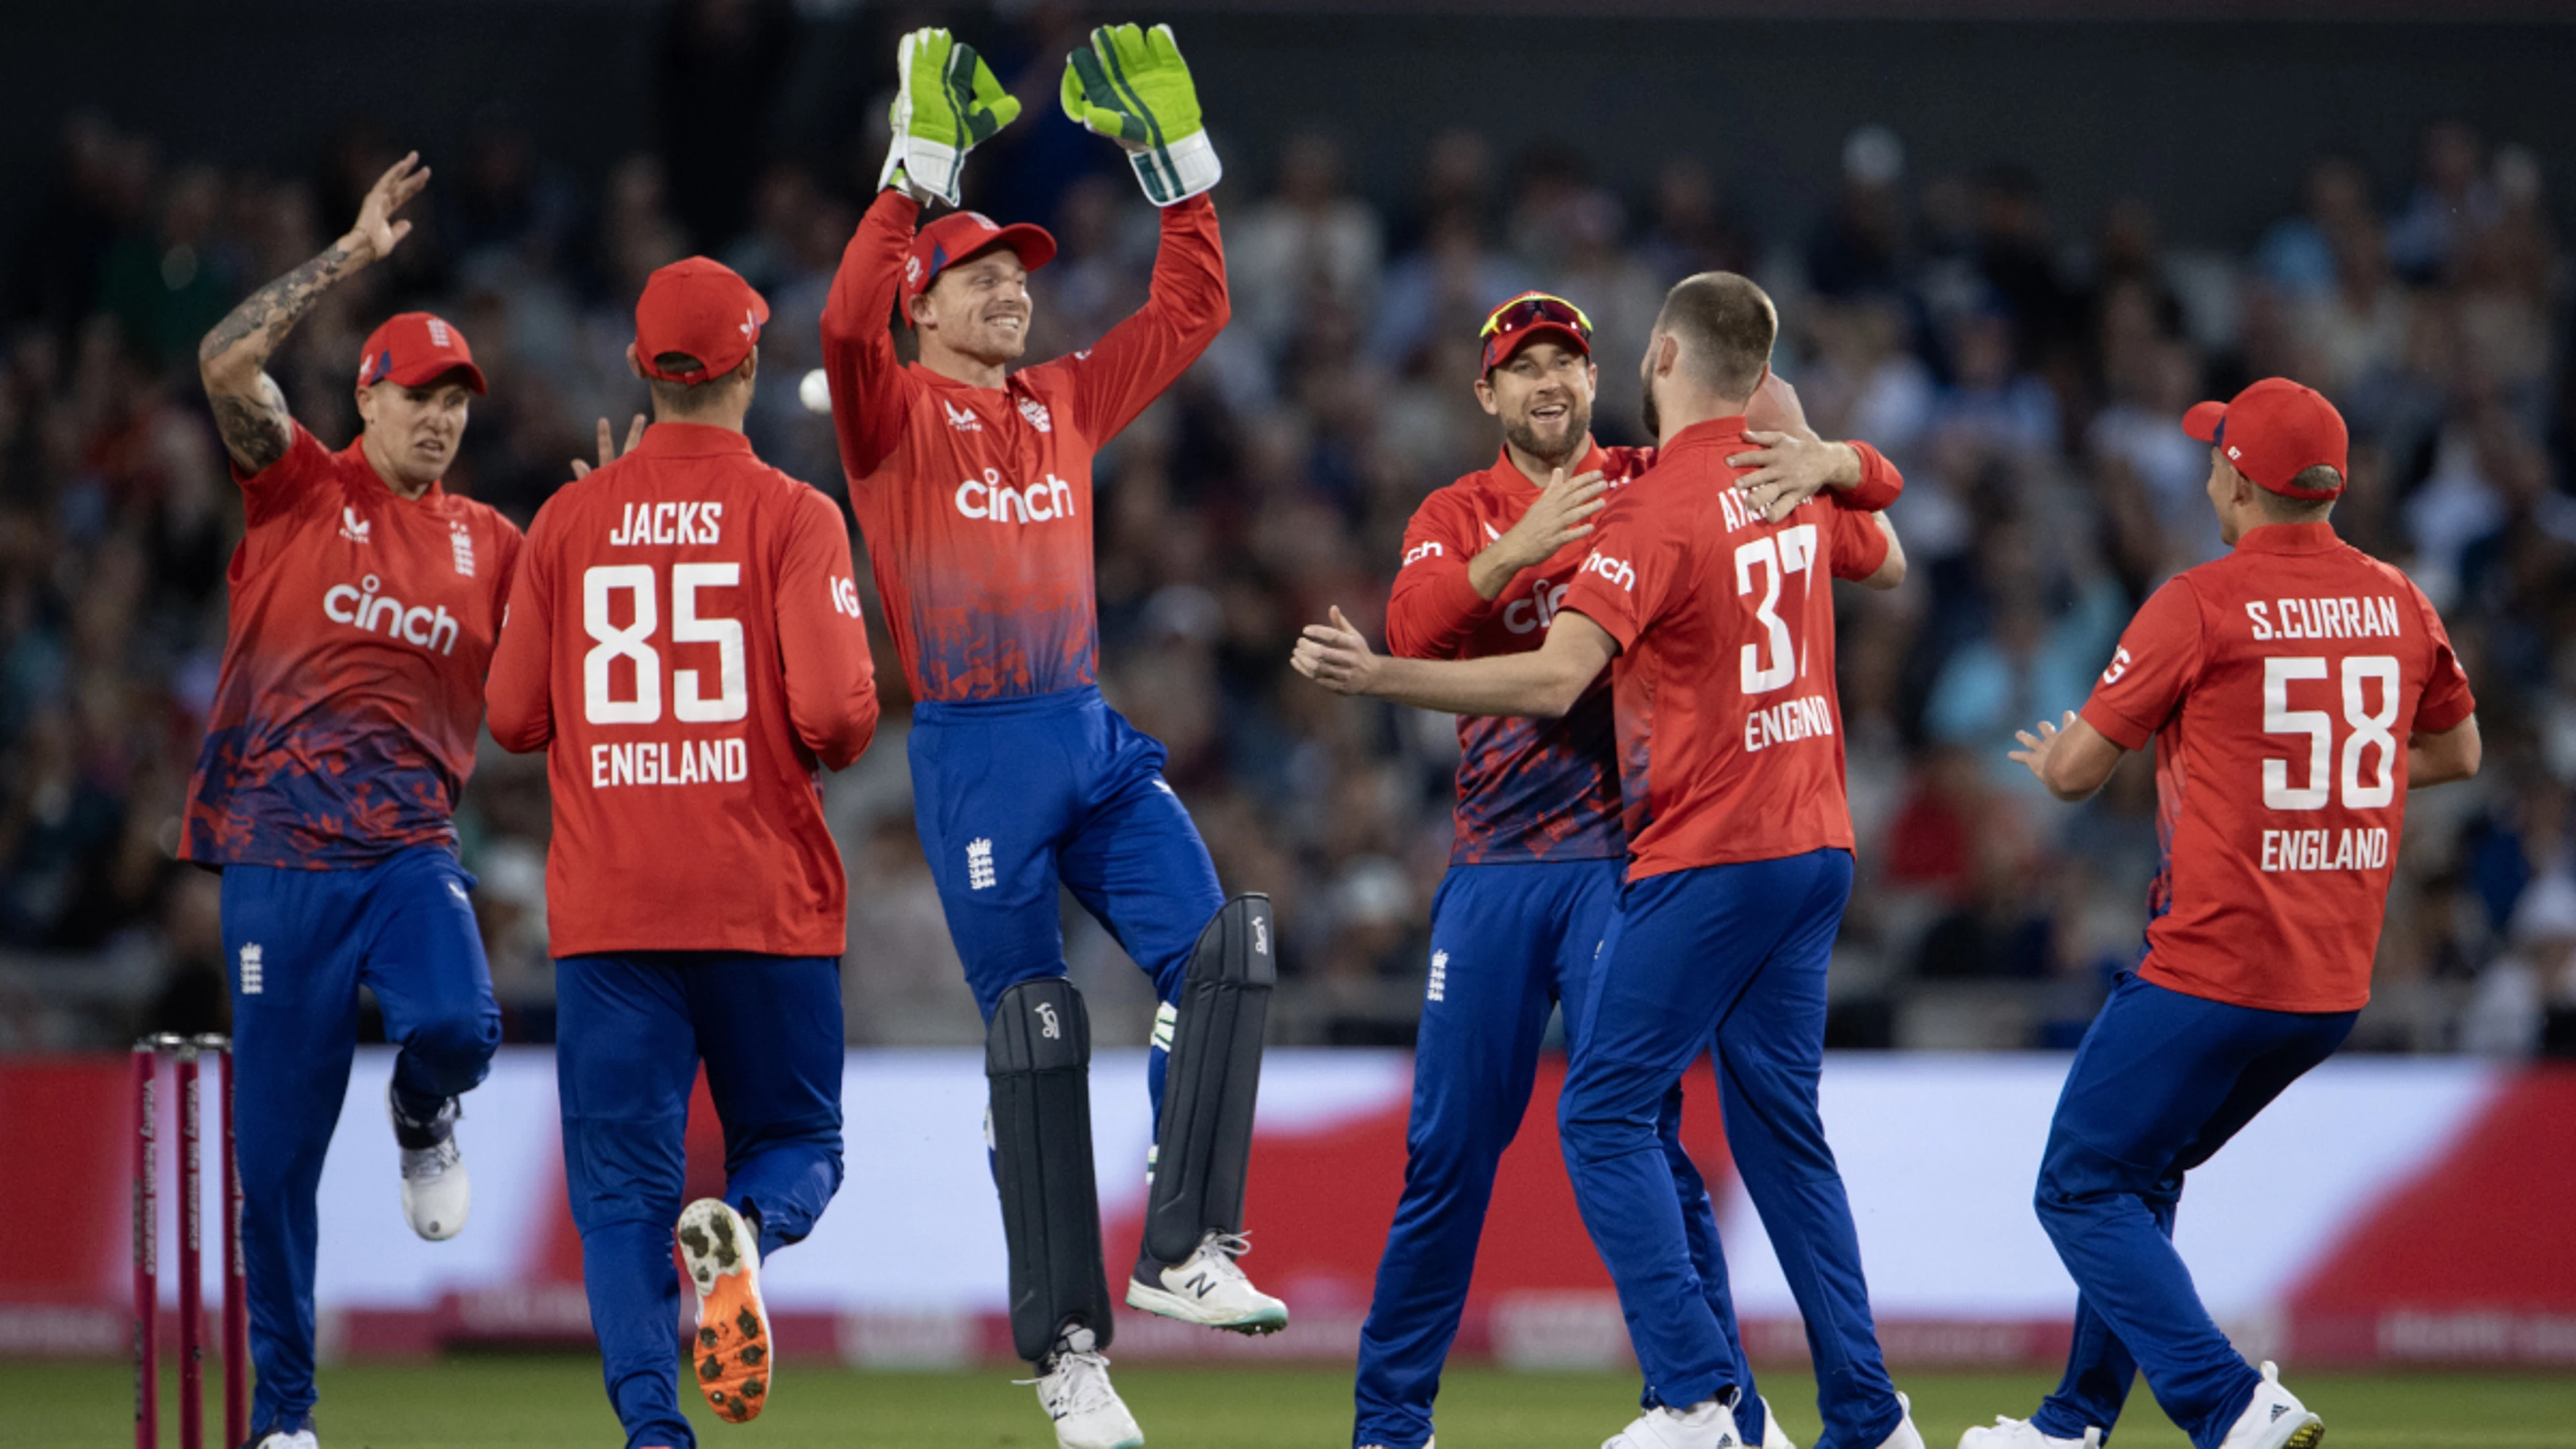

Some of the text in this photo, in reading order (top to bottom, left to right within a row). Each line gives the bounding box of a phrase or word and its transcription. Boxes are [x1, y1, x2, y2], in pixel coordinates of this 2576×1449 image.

[955, 468, 1075, 525] cinch
[610, 502, 722, 546] JACKS
[1580, 547, 1637, 593] nch
[323, 574, 460, 657] cinch
[830, 575, 862, 619] IG
[1735, 523, 1818, 694] 37
[2245, 596, 2401, 640] S.CURRAN
[583, 562, 749, 724] 85
[2262, 655, 2400, 810] 58
[591, 738, 748, 788] ENGLAND
[2261, 827, 2389, 871] ENGLAND
